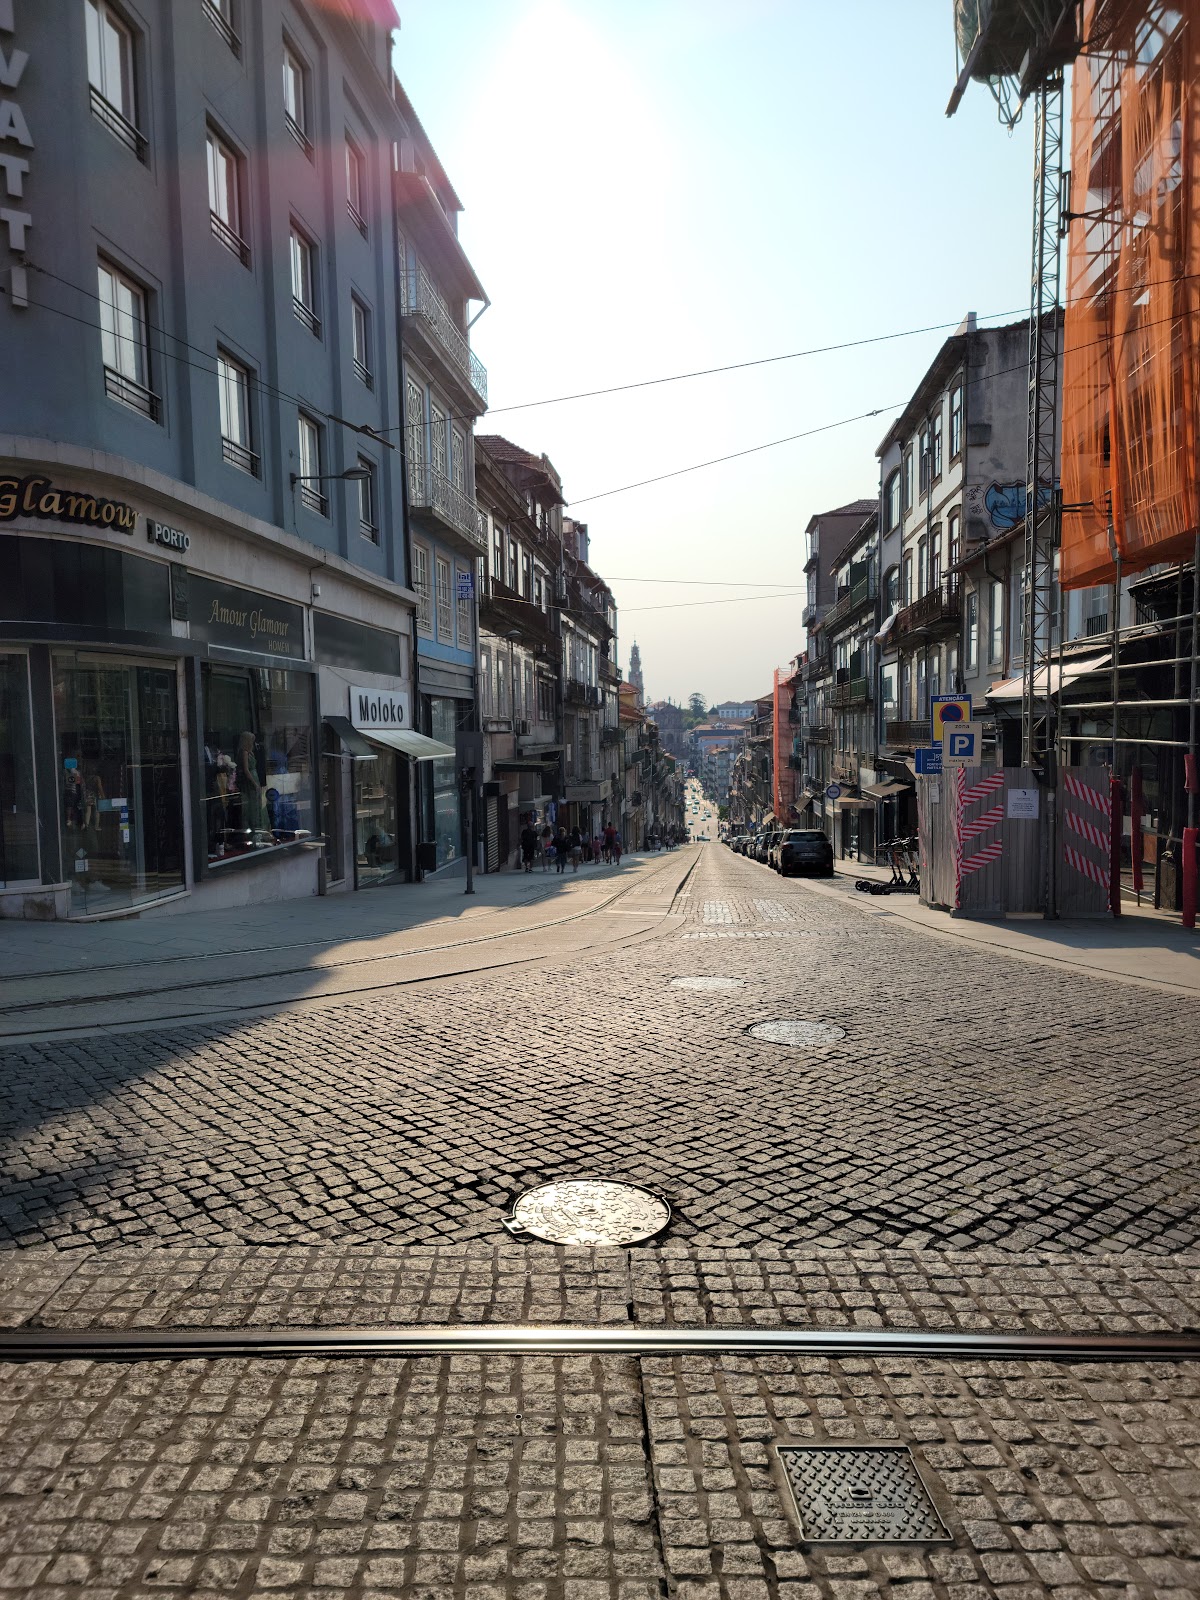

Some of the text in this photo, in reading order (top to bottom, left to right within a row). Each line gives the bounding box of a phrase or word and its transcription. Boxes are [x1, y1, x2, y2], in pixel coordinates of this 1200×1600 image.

[0, 479, 142, 531] Glamour
[154, 523, 191, 550] PORTO
[208, 599, 289, 639] Amour Glamour
[359, 695, 403, 723] Moloko
[954, 736, 970, 755] P
